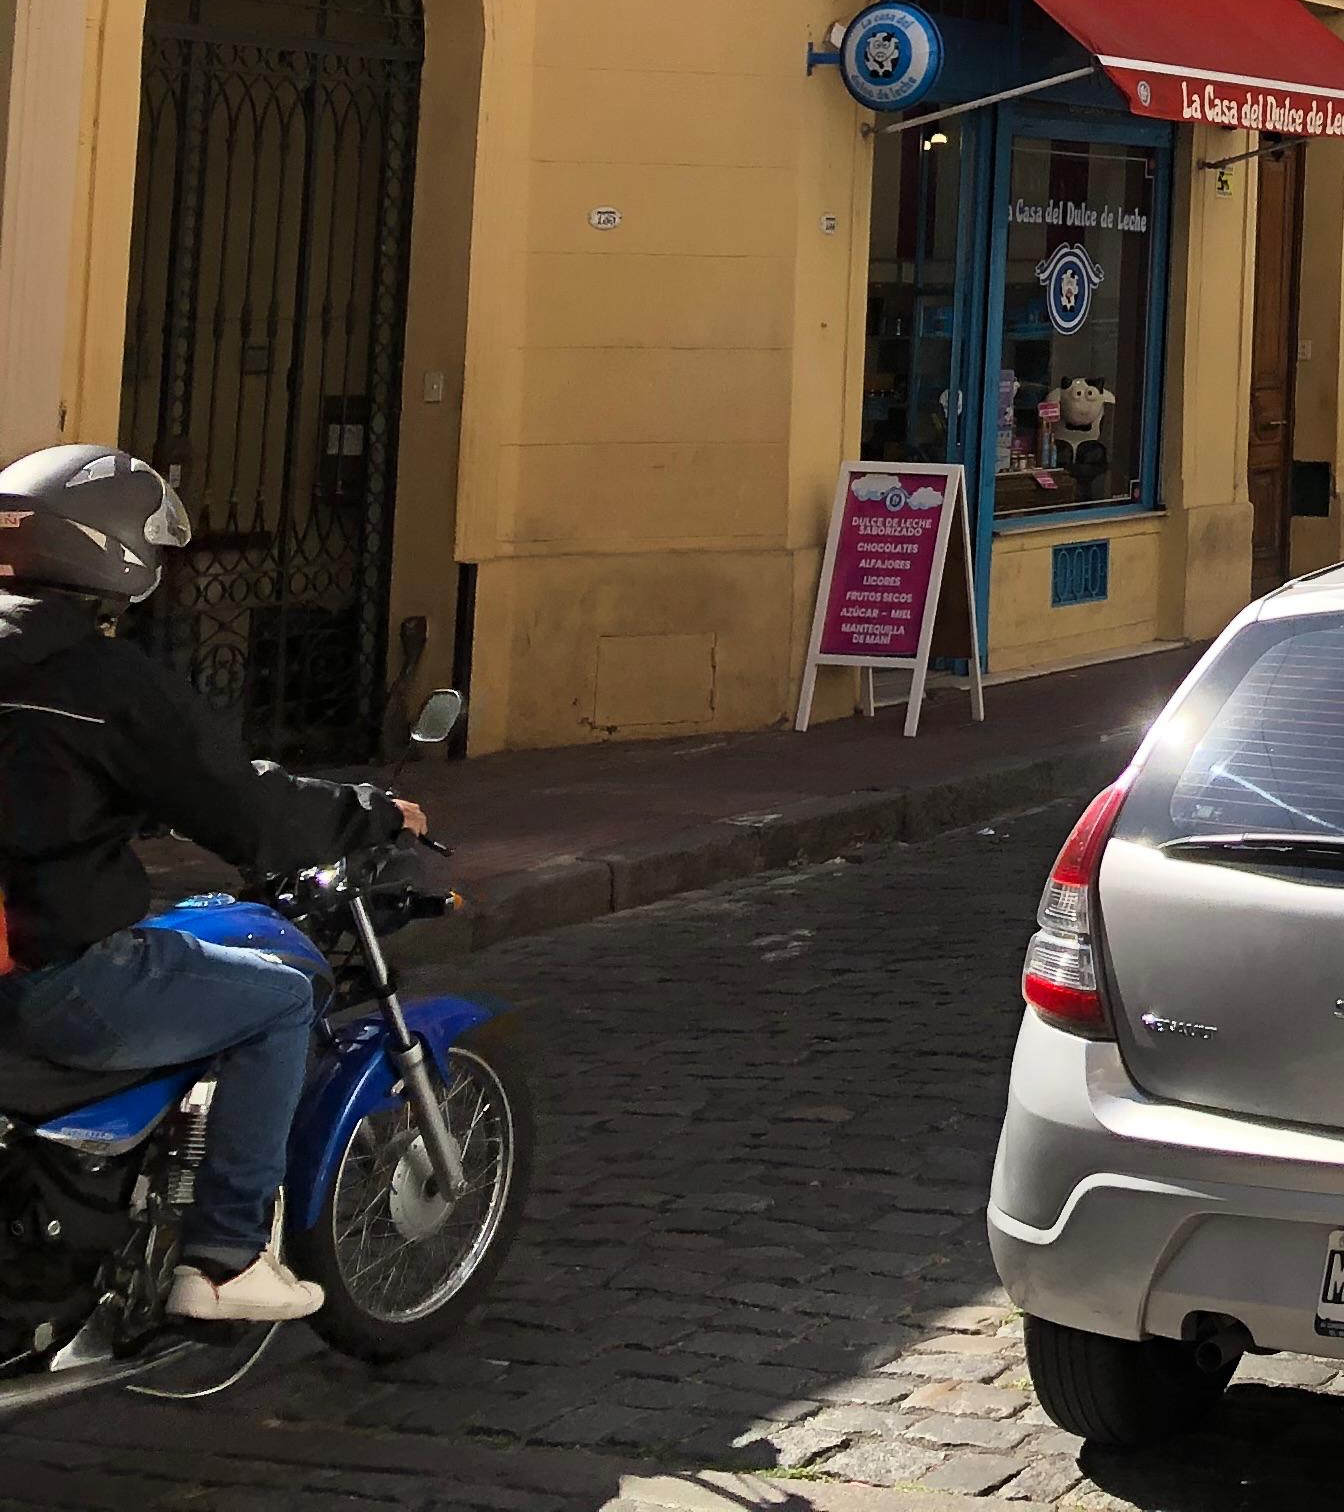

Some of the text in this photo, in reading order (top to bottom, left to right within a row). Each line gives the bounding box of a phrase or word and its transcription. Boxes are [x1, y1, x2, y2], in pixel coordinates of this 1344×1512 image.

[1181, 81, 1201, 119] La
[1204, 84, 1238, 125] Casa
[1241, 92, 1263, 128] del
[1266, 95, 1304, 133] Dulce
[1307, 100, 1324, 135] de
[1016, 199, 1043, 223] Casa
[1045, 199, 1063, 225] del
[1066, 202, 1097, 227] Dulce
[1100, 204, 1114, 228] de
[1118, 208, 1147, 233] Leche
[852, 517, 932, 528] DULCE DE LECHE
[859, 526, 923, 536] SABORIZADO
[857, 542, 919, 553] CHOCOLATES
[859, 559, 911, 569] ALFAJORES
[863, 576, 901, 586] LICORES
[846, 591, 913, 603] FRUTOS SECOS
[840, 606, 878, 618] AZÚCAR
[891, 609, 911, 619] MIEL
[841, 623, 905, 635] MANTEQUILLA
[852, 633, 863, 644] DE
